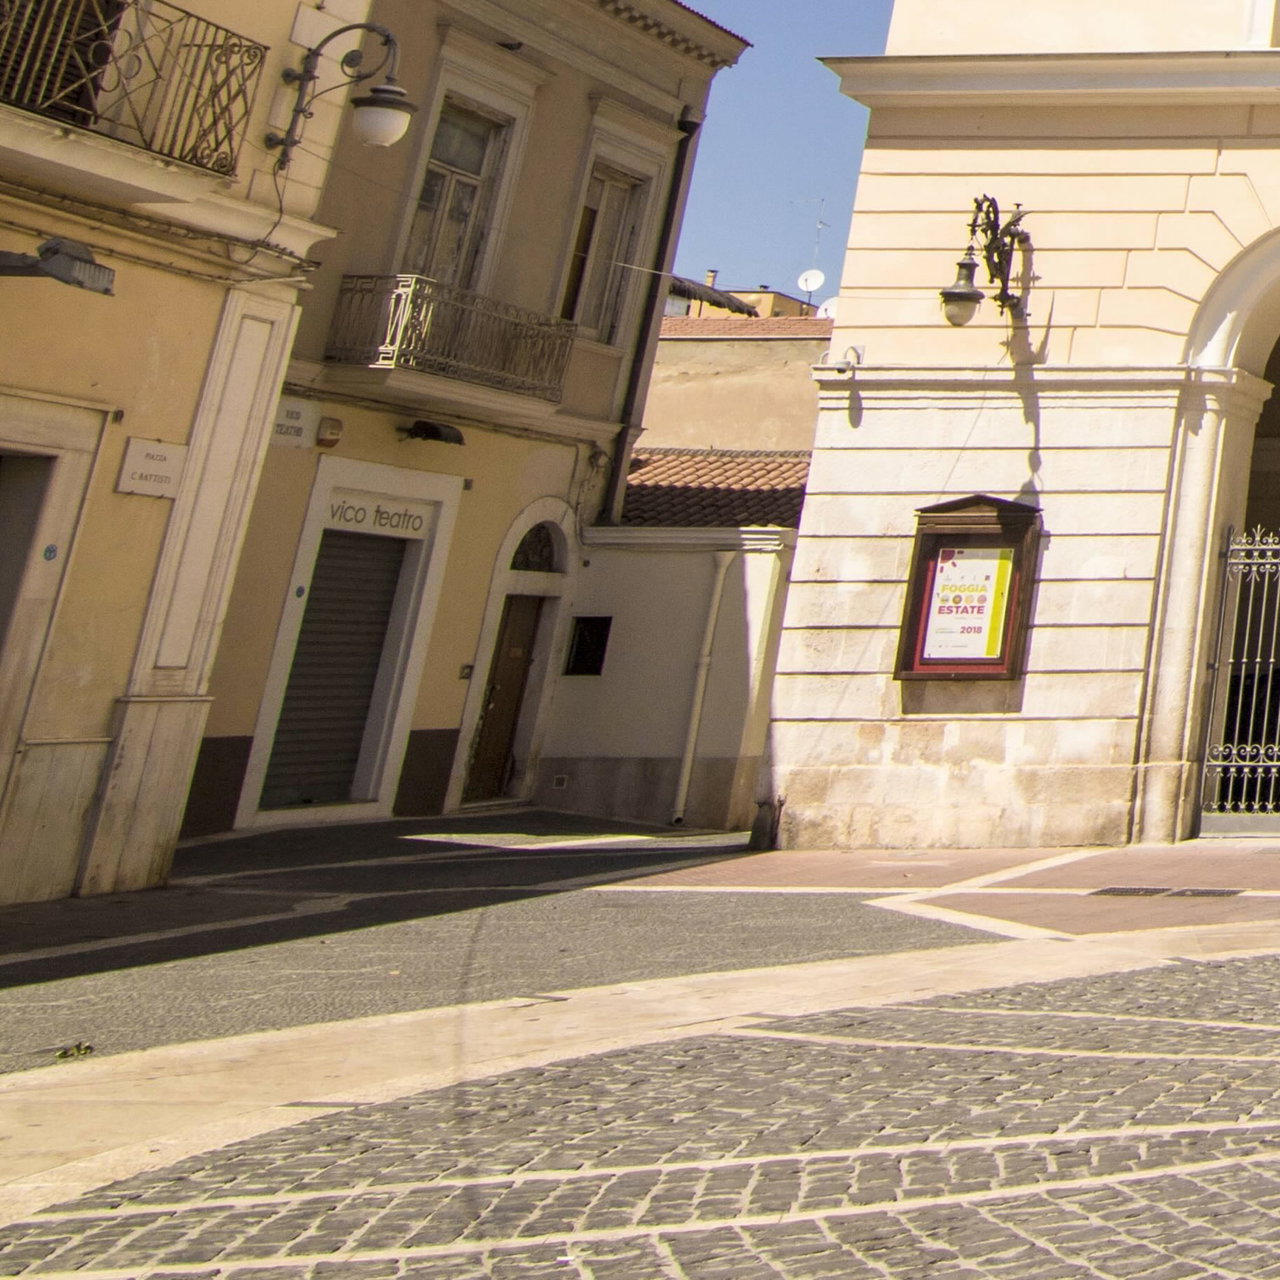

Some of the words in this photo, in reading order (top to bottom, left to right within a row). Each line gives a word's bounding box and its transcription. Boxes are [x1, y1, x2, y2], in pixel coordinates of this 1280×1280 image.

[145, 453, 167, 463] PIAZZA
[331, 501, 367, 523] vico
[373, 504, 423, 531] teatro
[942, 584, 988, 592] FOGGIA
[938, 606, 985, 614] ESTATE
[960, 626, 983, 634] 2018
